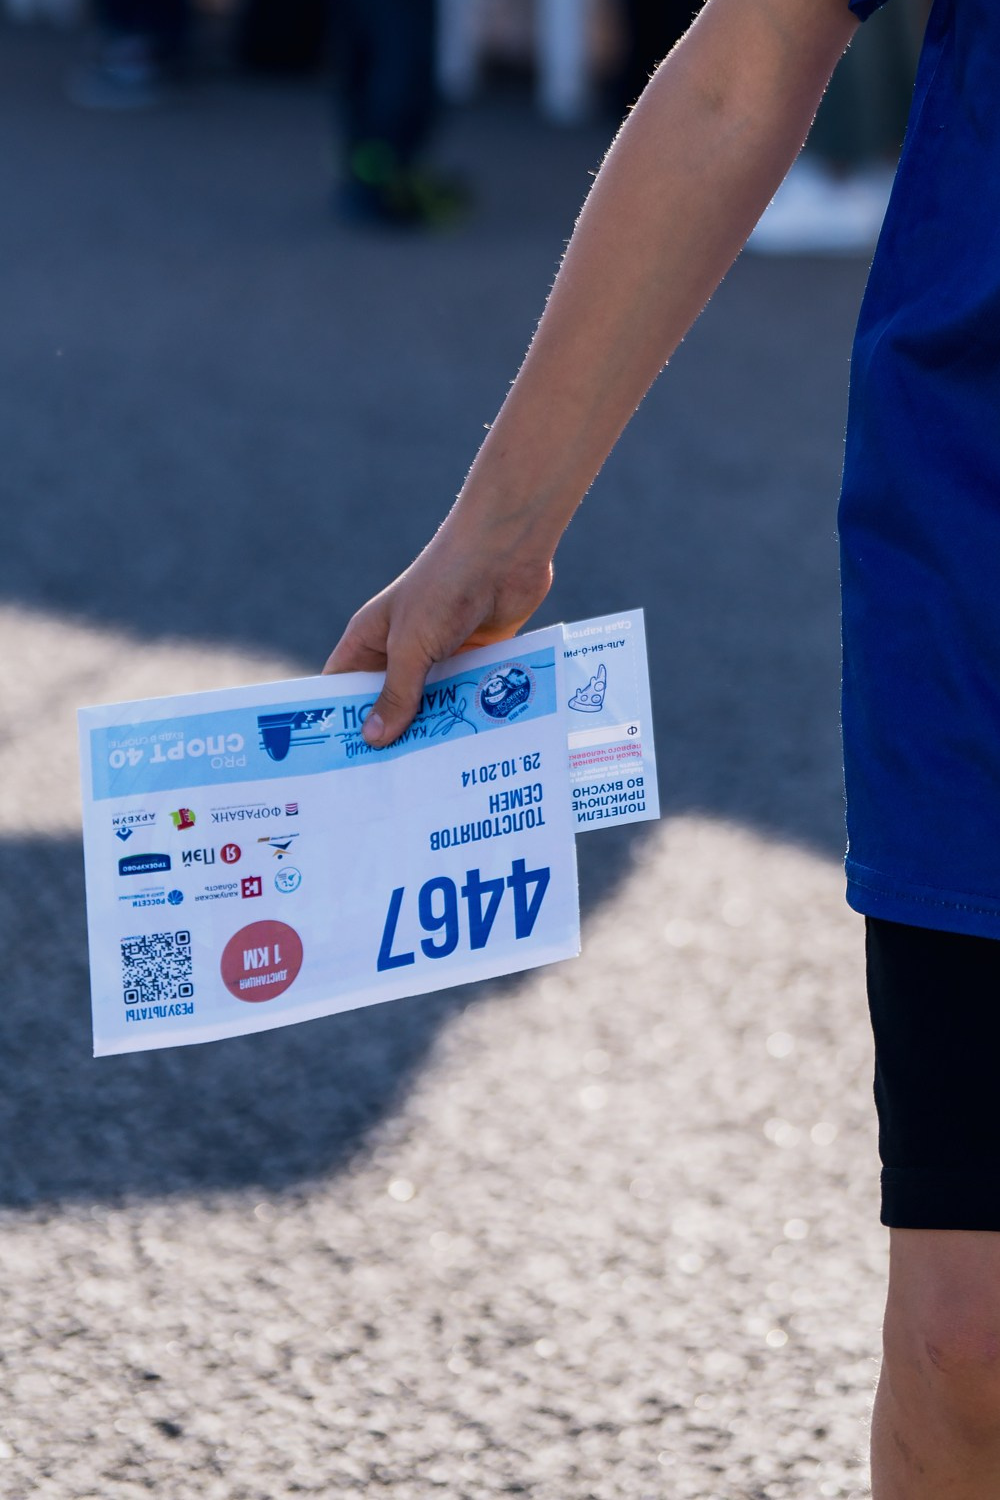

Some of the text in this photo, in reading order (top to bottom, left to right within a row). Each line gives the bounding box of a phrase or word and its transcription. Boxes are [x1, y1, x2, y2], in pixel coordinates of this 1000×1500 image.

[158, 731, 184, 742] БУДЬ
[108, 732, 244, 769] СПОРТ 40
[616, 751, 642, 761] Какой
[210, 754, 247, 769] PRO
[461, 752, 541, 787] 29.10.2014
[572, 777, 644, 798] ВО ВКУСНО
[489, 783, 543, 814] СЕМЕН
[112, 812, 156, 826] АРХБУМ
[210, 806, 281, 823] ФОРАБАНК
[577, 801, 646, 823] ПОЛЕТЕЛИ
[430, 807, 545, 851] ТОЛСТОПЯТОВ
[182, 847, 215, 867] Пэй
[194, 889, 239, 902] калужская
[205, 883, 238, 892] область
[132, 898, 166, 908] РОССЕТИ
[377, 858, 550, 972] 4467
[243, 944, 281, 971] 1 КМ
[239, 969, 288, 990] ДИСТАНЦИЯ
[125, 1002, 194, 1022] РЕЗУЛЬТАТЫ
